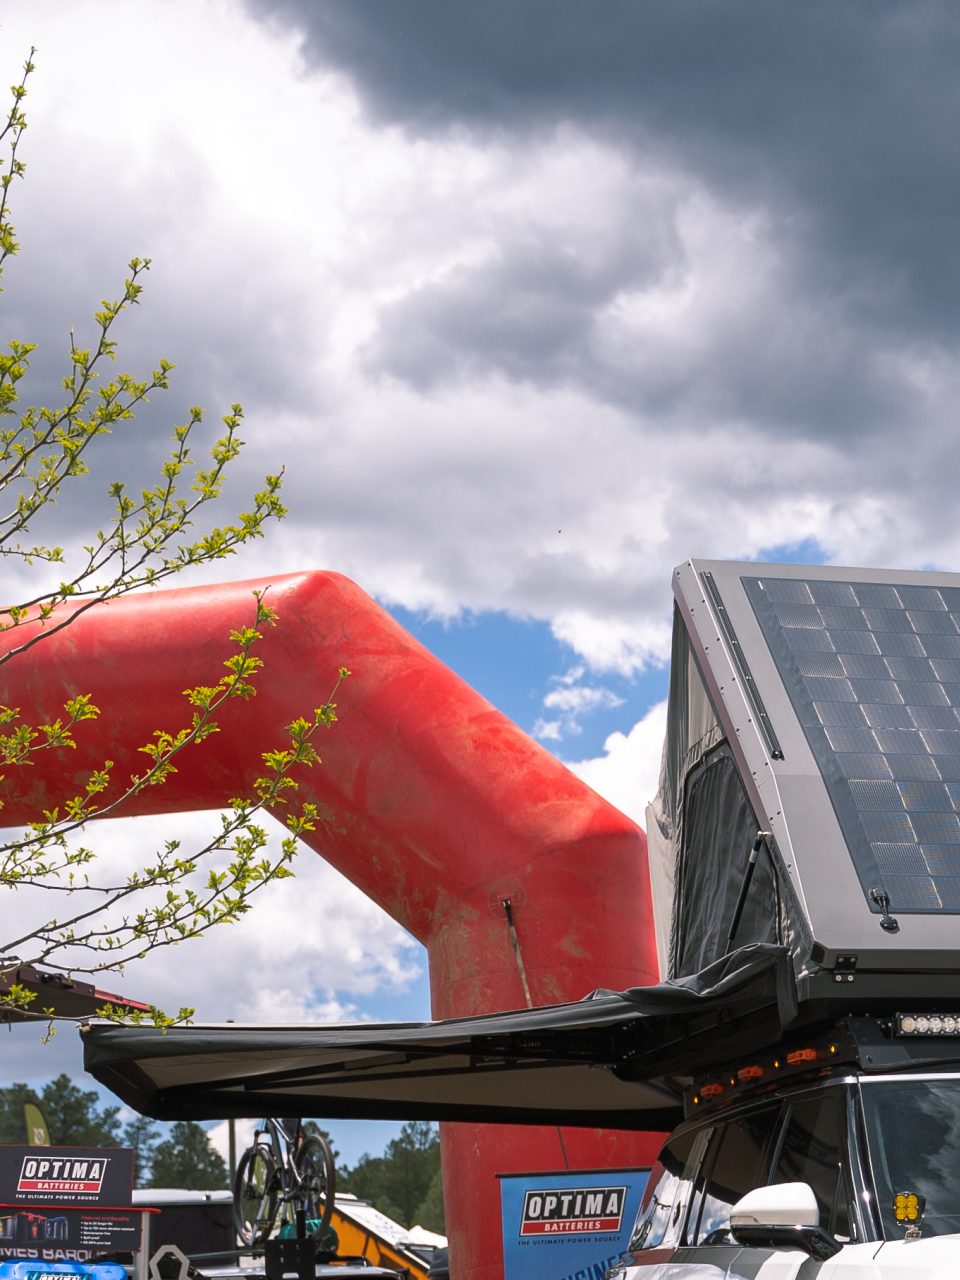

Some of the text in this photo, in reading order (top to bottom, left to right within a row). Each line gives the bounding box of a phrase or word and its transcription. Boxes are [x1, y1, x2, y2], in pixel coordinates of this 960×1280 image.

[25, 1161, 100, 1179] OPTIMA
[37, 1182, 85, 1190] BATTERIES
[527, 1192, 619, 1218] OPTIMA
[544, 1221, 601, 1232] BATTERIES
